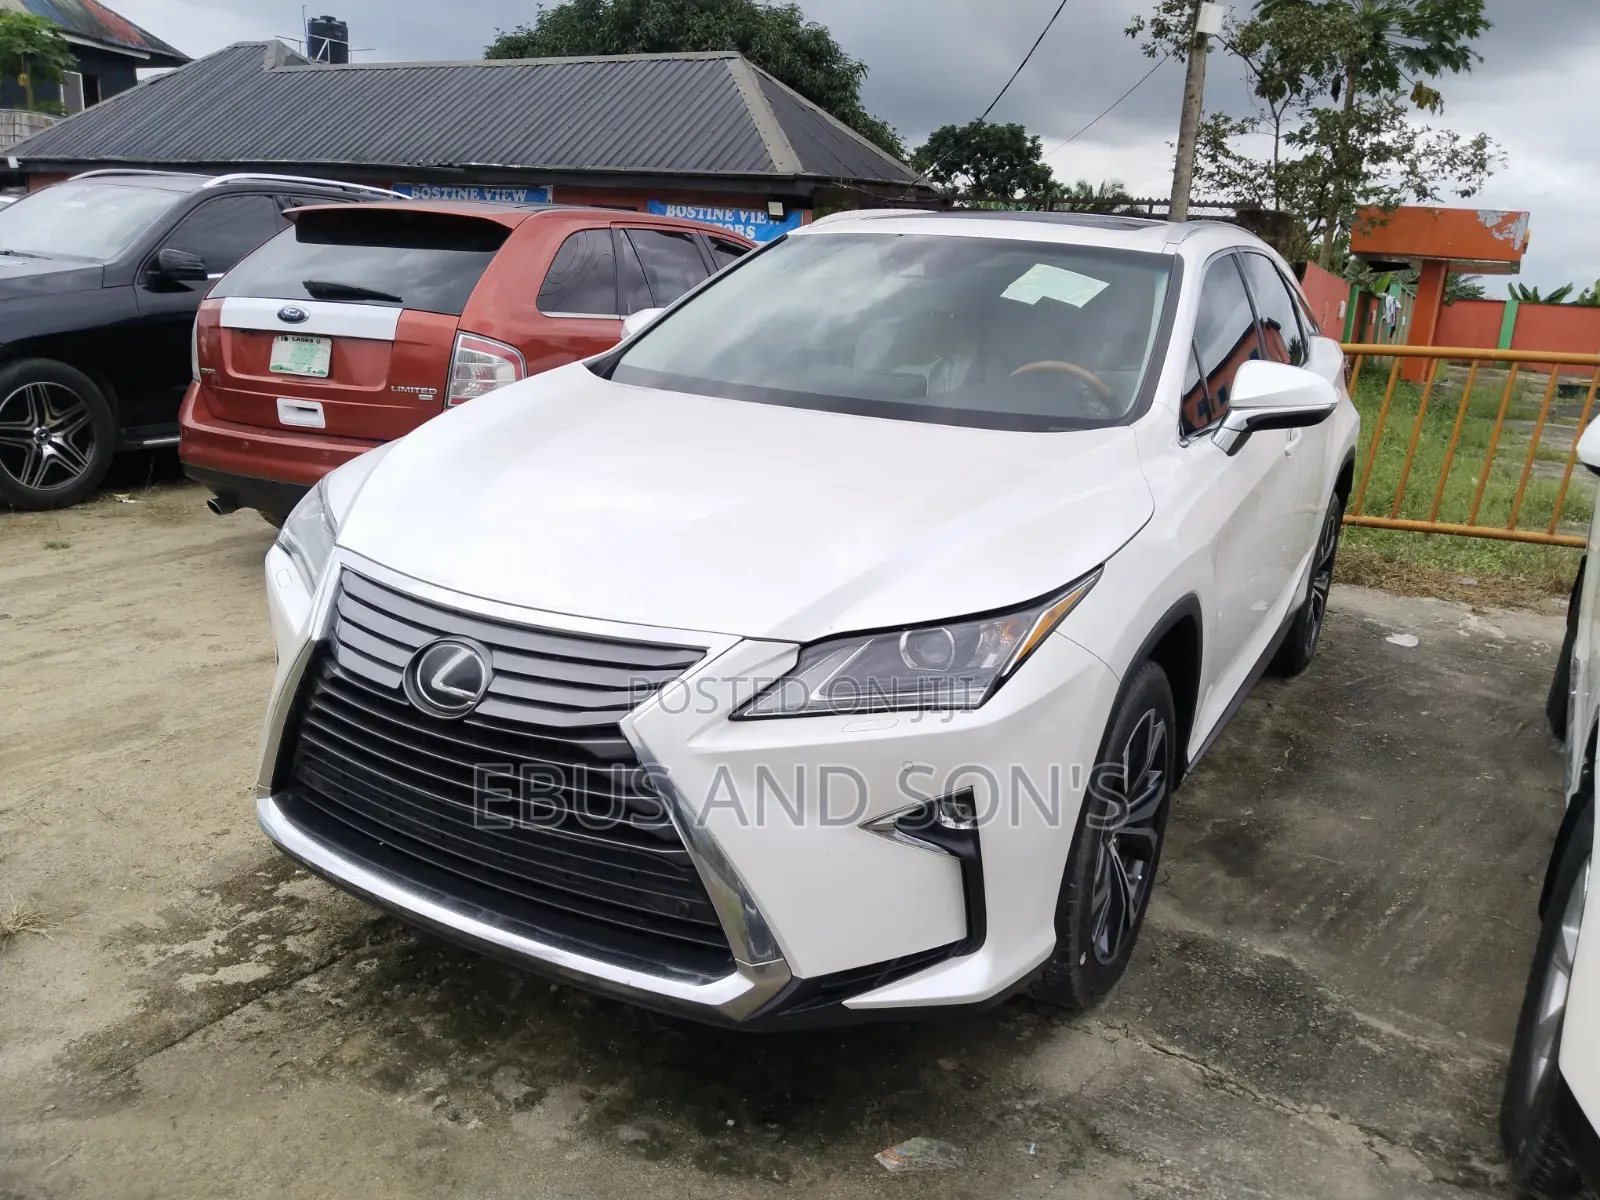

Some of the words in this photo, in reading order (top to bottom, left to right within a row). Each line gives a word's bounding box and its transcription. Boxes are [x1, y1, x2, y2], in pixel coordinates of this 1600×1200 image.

[411, 186, 480, 200] BOSTINE
[483, 188, 528, 202] VIEW
[665, 205, 735, 222] BOSTINE
[739, 210, 781, 226] VIE
[391, 385, 438, 395] LIMITED
